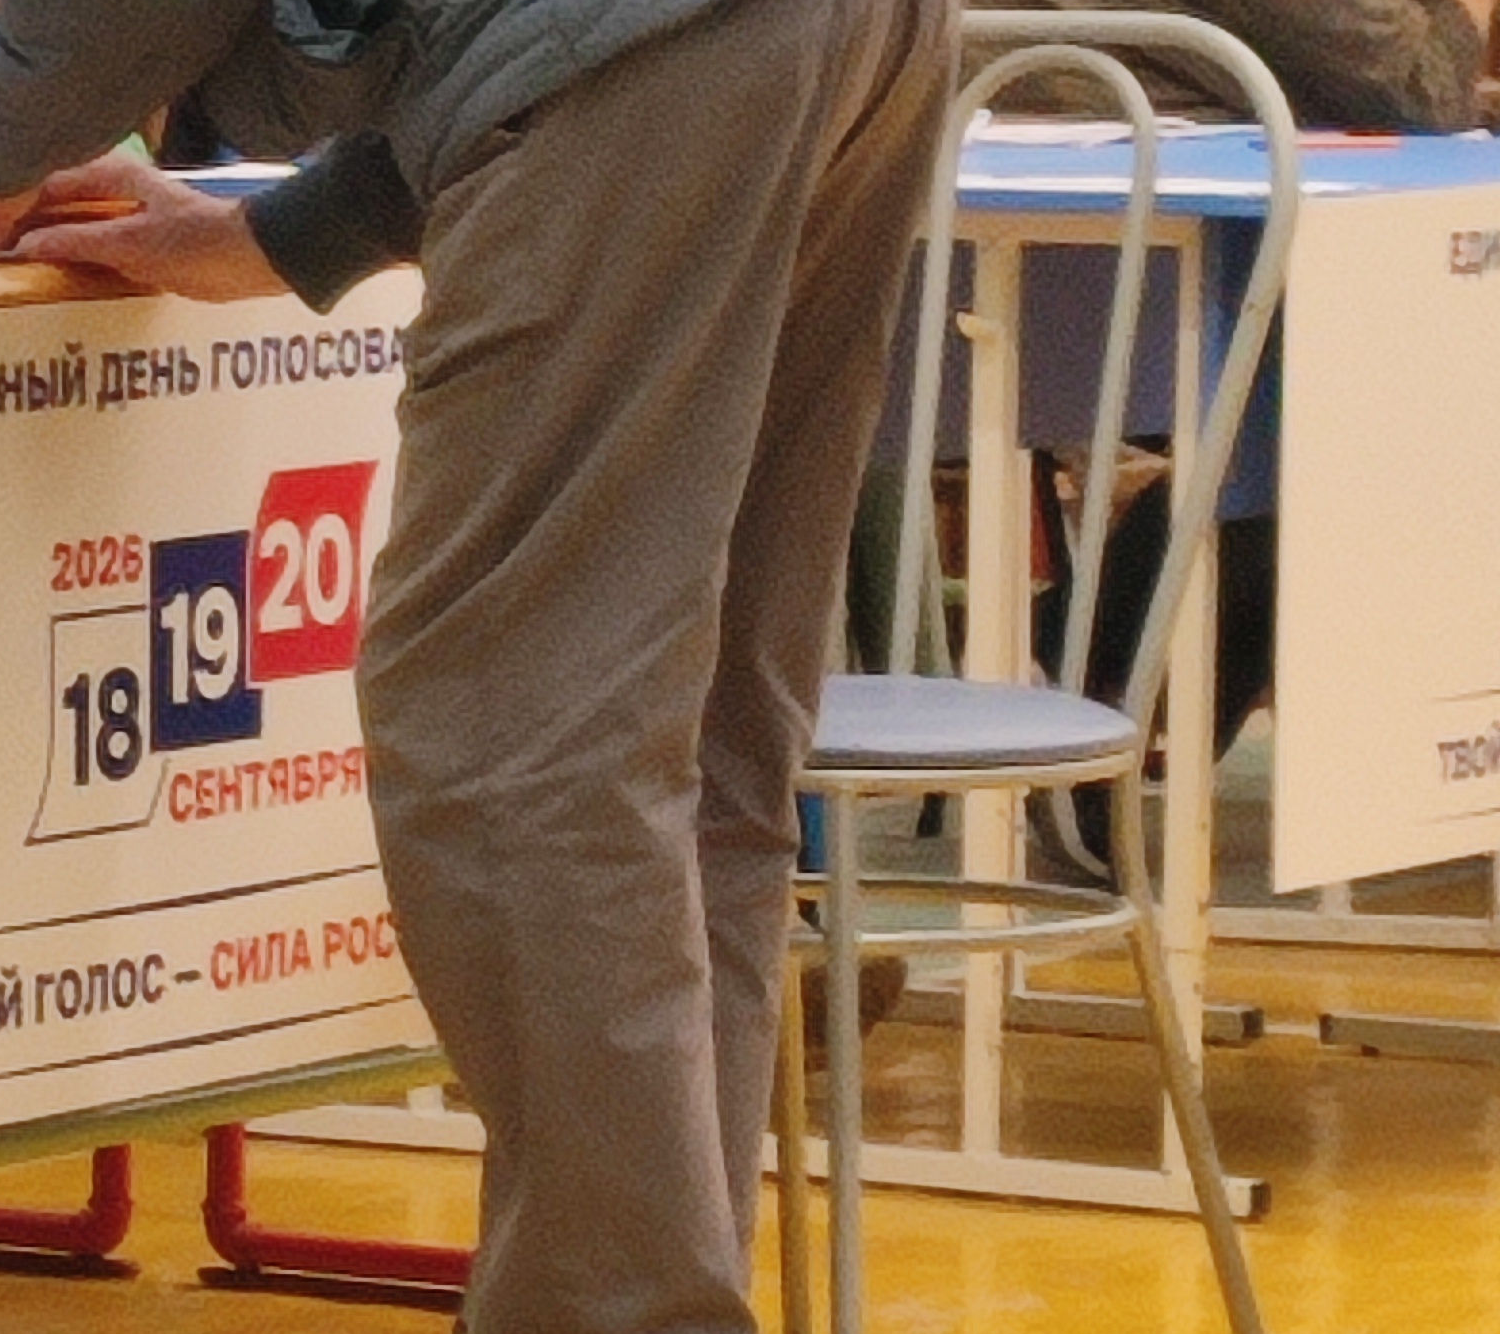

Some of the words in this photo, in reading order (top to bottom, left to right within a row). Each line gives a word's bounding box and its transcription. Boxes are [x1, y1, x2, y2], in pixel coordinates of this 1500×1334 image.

[96, 345, 200, 413] ДЕНЬ
[51, 533, 144, 592] 2026
[62, 666, 143, 786] 18
[160, 585, 239, 706] 19
[259, 513, 352, 634] 20
[168, 746, 364, 824] СЕНТЯБРЯ
[34, 952, 168, 1025] ГОЛОС
[210, 927, 313, 991] СИЛА
[322, 911, 398, 971] РОС
